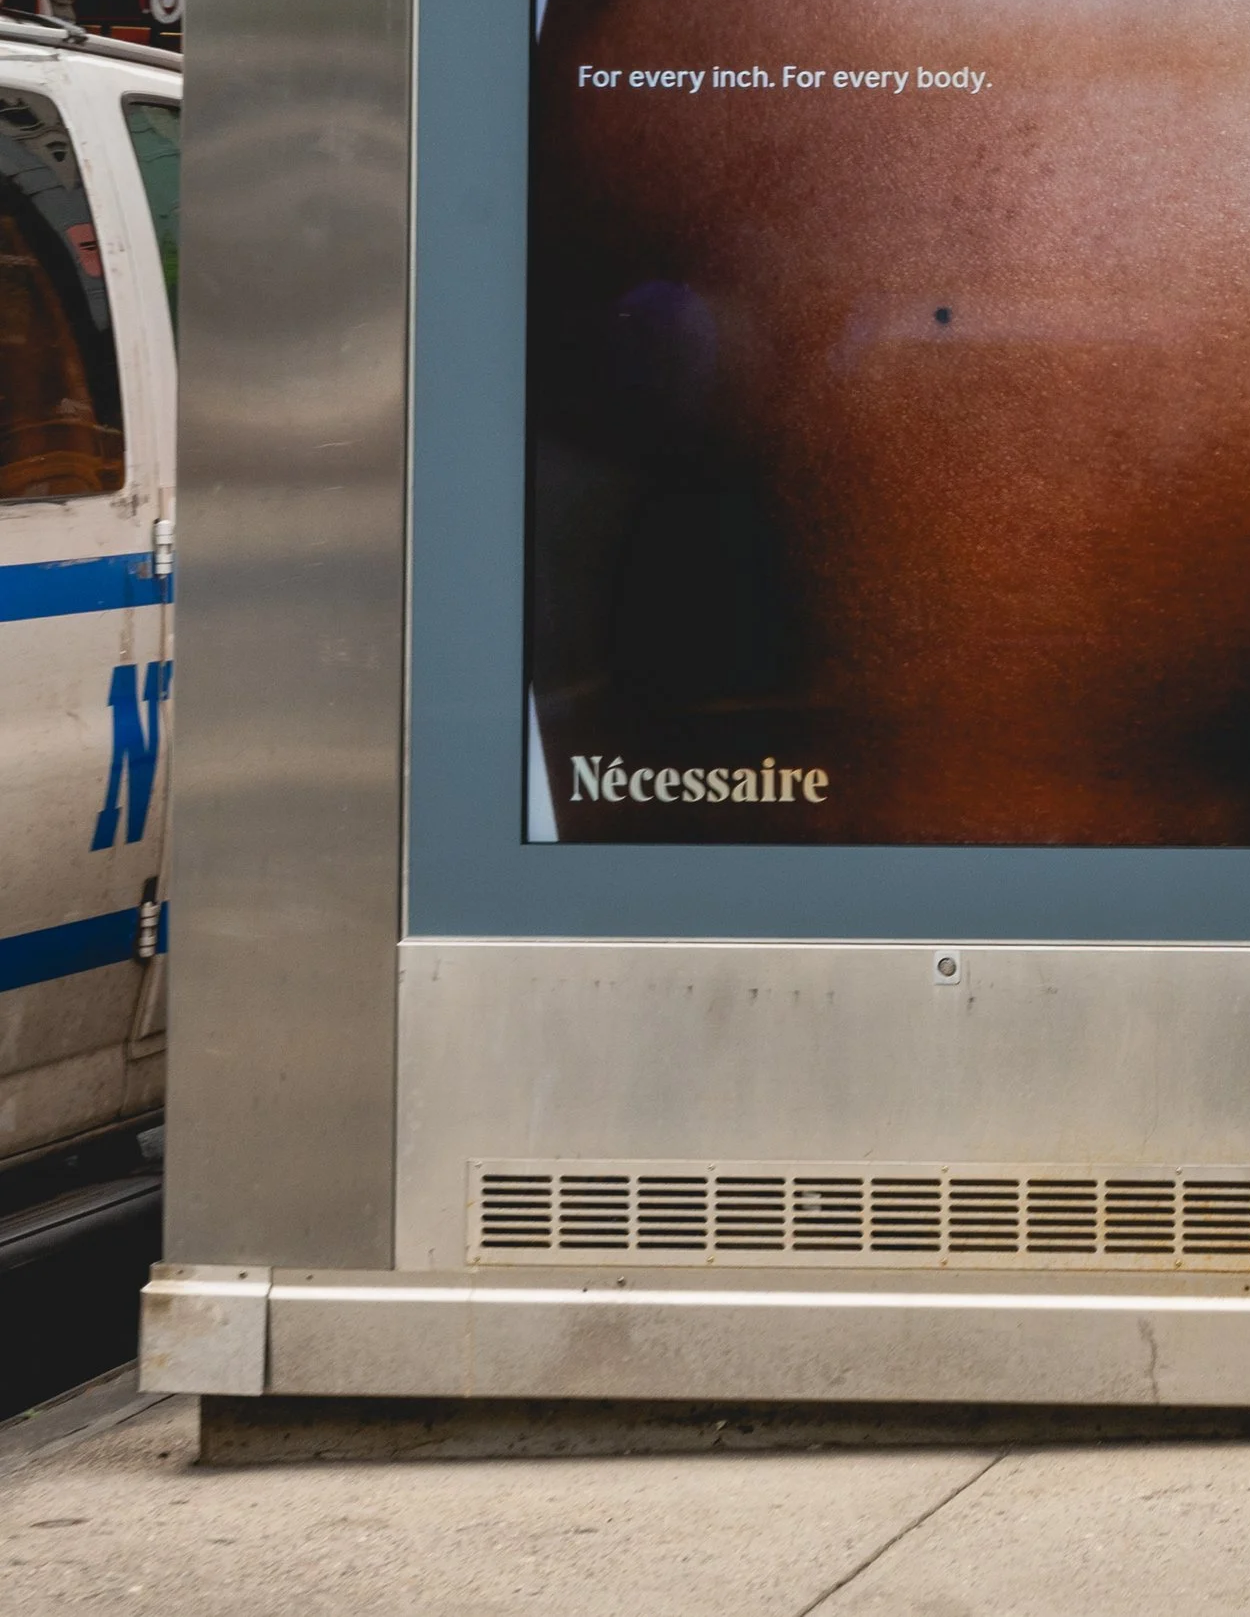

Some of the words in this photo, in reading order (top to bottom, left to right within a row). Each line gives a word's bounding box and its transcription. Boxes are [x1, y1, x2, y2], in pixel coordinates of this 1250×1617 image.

[577, 65, 623, 88] For
[628, 68, 706, 94] every
[712, 65, 776, 88] inch.
[782, 65, 827, 88] For
[833, 68, 910, 94] every
[916, 65, 993, 94] body.
[90, 660, 174, 852] N
[569, 755, 830, 804] Nécessaire
